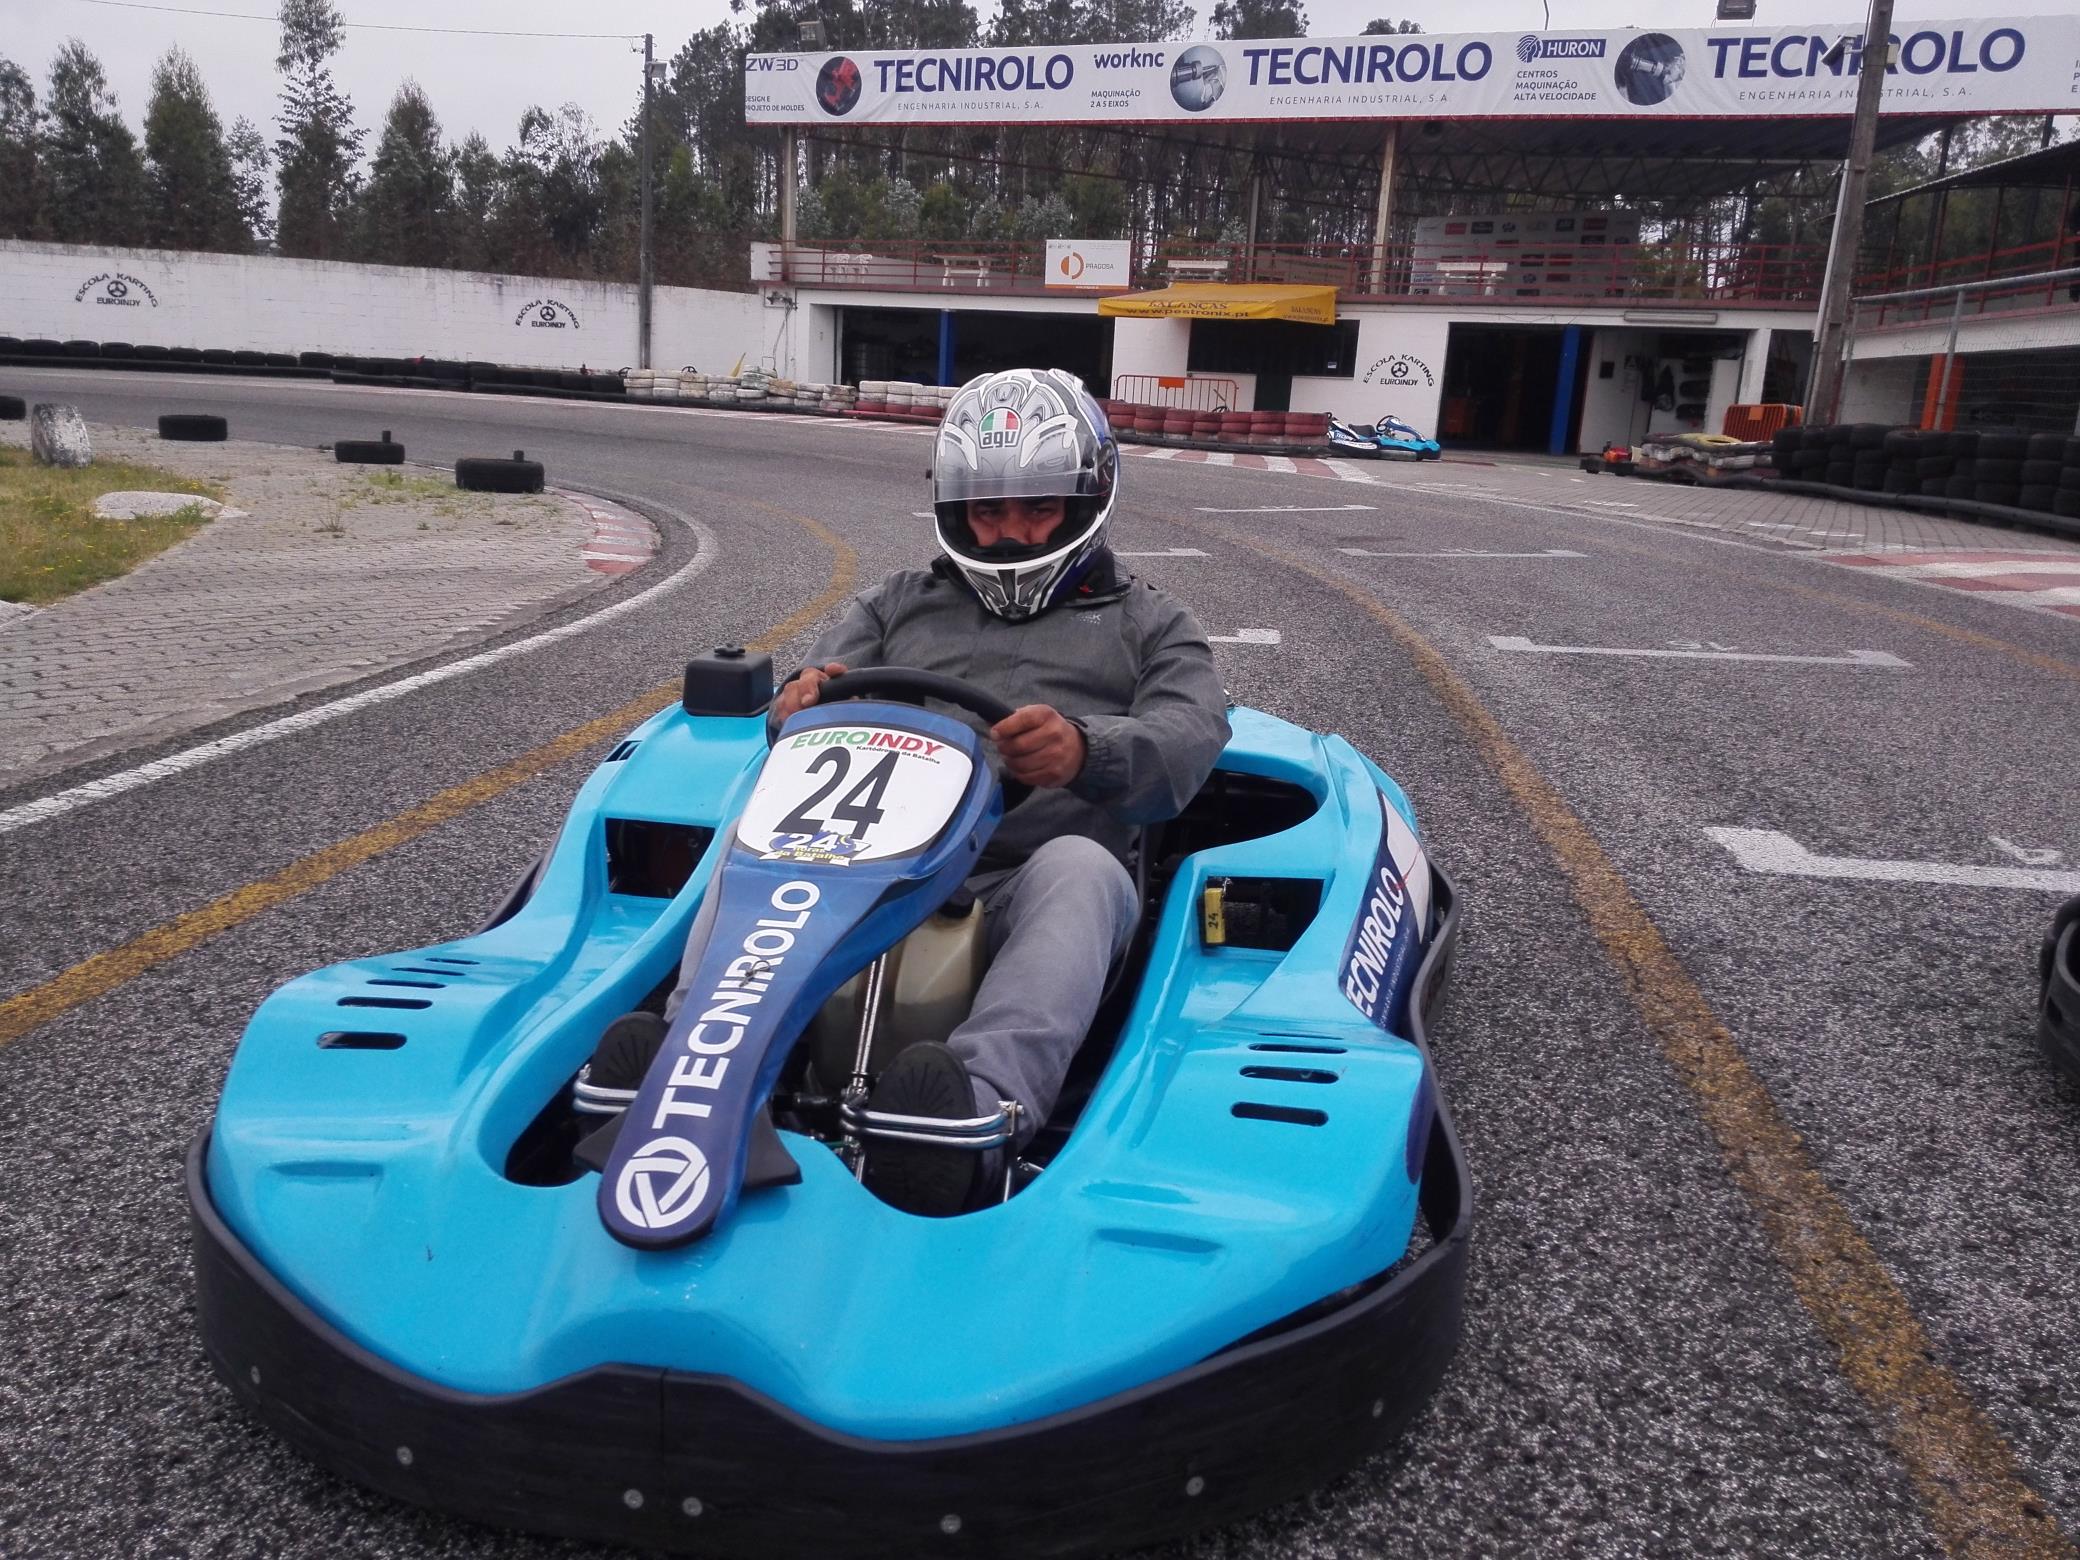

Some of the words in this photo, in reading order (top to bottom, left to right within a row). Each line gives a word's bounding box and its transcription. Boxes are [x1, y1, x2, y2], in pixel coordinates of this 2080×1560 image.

[1546, 41, 1601, 56] HURON
[744, 58, 799, 72] ZW3D
[1093, 47, 1165, 69] worknc
[1242, 41, 1492, 85] TECNIROLO
[873, 53, 1074, 93] TECNIROLO
[1516, 70, 1558, 79] CENTROS
[1091, 88, 1141, 98] MAQUINAÇÃO
[1515, 79, 1578, 91] MAQUINAÇÃO
[1269, 96, 1343, 105] ENGENHARIA
[1348, 94, 1423, 104] INDUSTRIAL,
[1513, 92, 1538, 101] ALTA
[1539, 92, 1597, 101] VELOCIDADE
[1738, 90, 1832, 101] ENGENHARIA
[1839, 88, 1935, 98] INSTRIAL,
[1942, 87, 1973, 97] S.A.
[897, 102, 957, 111] ENGENHARIA
[961, 101, 1020, 110] INDUSTRIAL,
[75, 273, 110, 302] ESCOLA
[116, 273, 159, 307] KARTING
[96, 297, 141, 307] EUROINDY
[515, 299, 543, 326] ESCOLA
[547, 299, 580, 329] KARTING
[531, 320, 566, 329] EUROINDY
[1363, 354, 1396, 384] ESCOLA
[1401, 354, 1435, 387] KARTING
[1380, 377, 1419, 386] EUROINDY
[790, 730, 946, 757] EUROINDY
[856, 746, 900, 755] Kartódroo
[912, 753, 941, 765] Batalha
[772, 746, 901, 841] 24
[782, 833, 840, 852] 24
[1346, 867, 1404, 1018] ECNIROLO
[652, 880, 821, 1130] TECNIROLO
